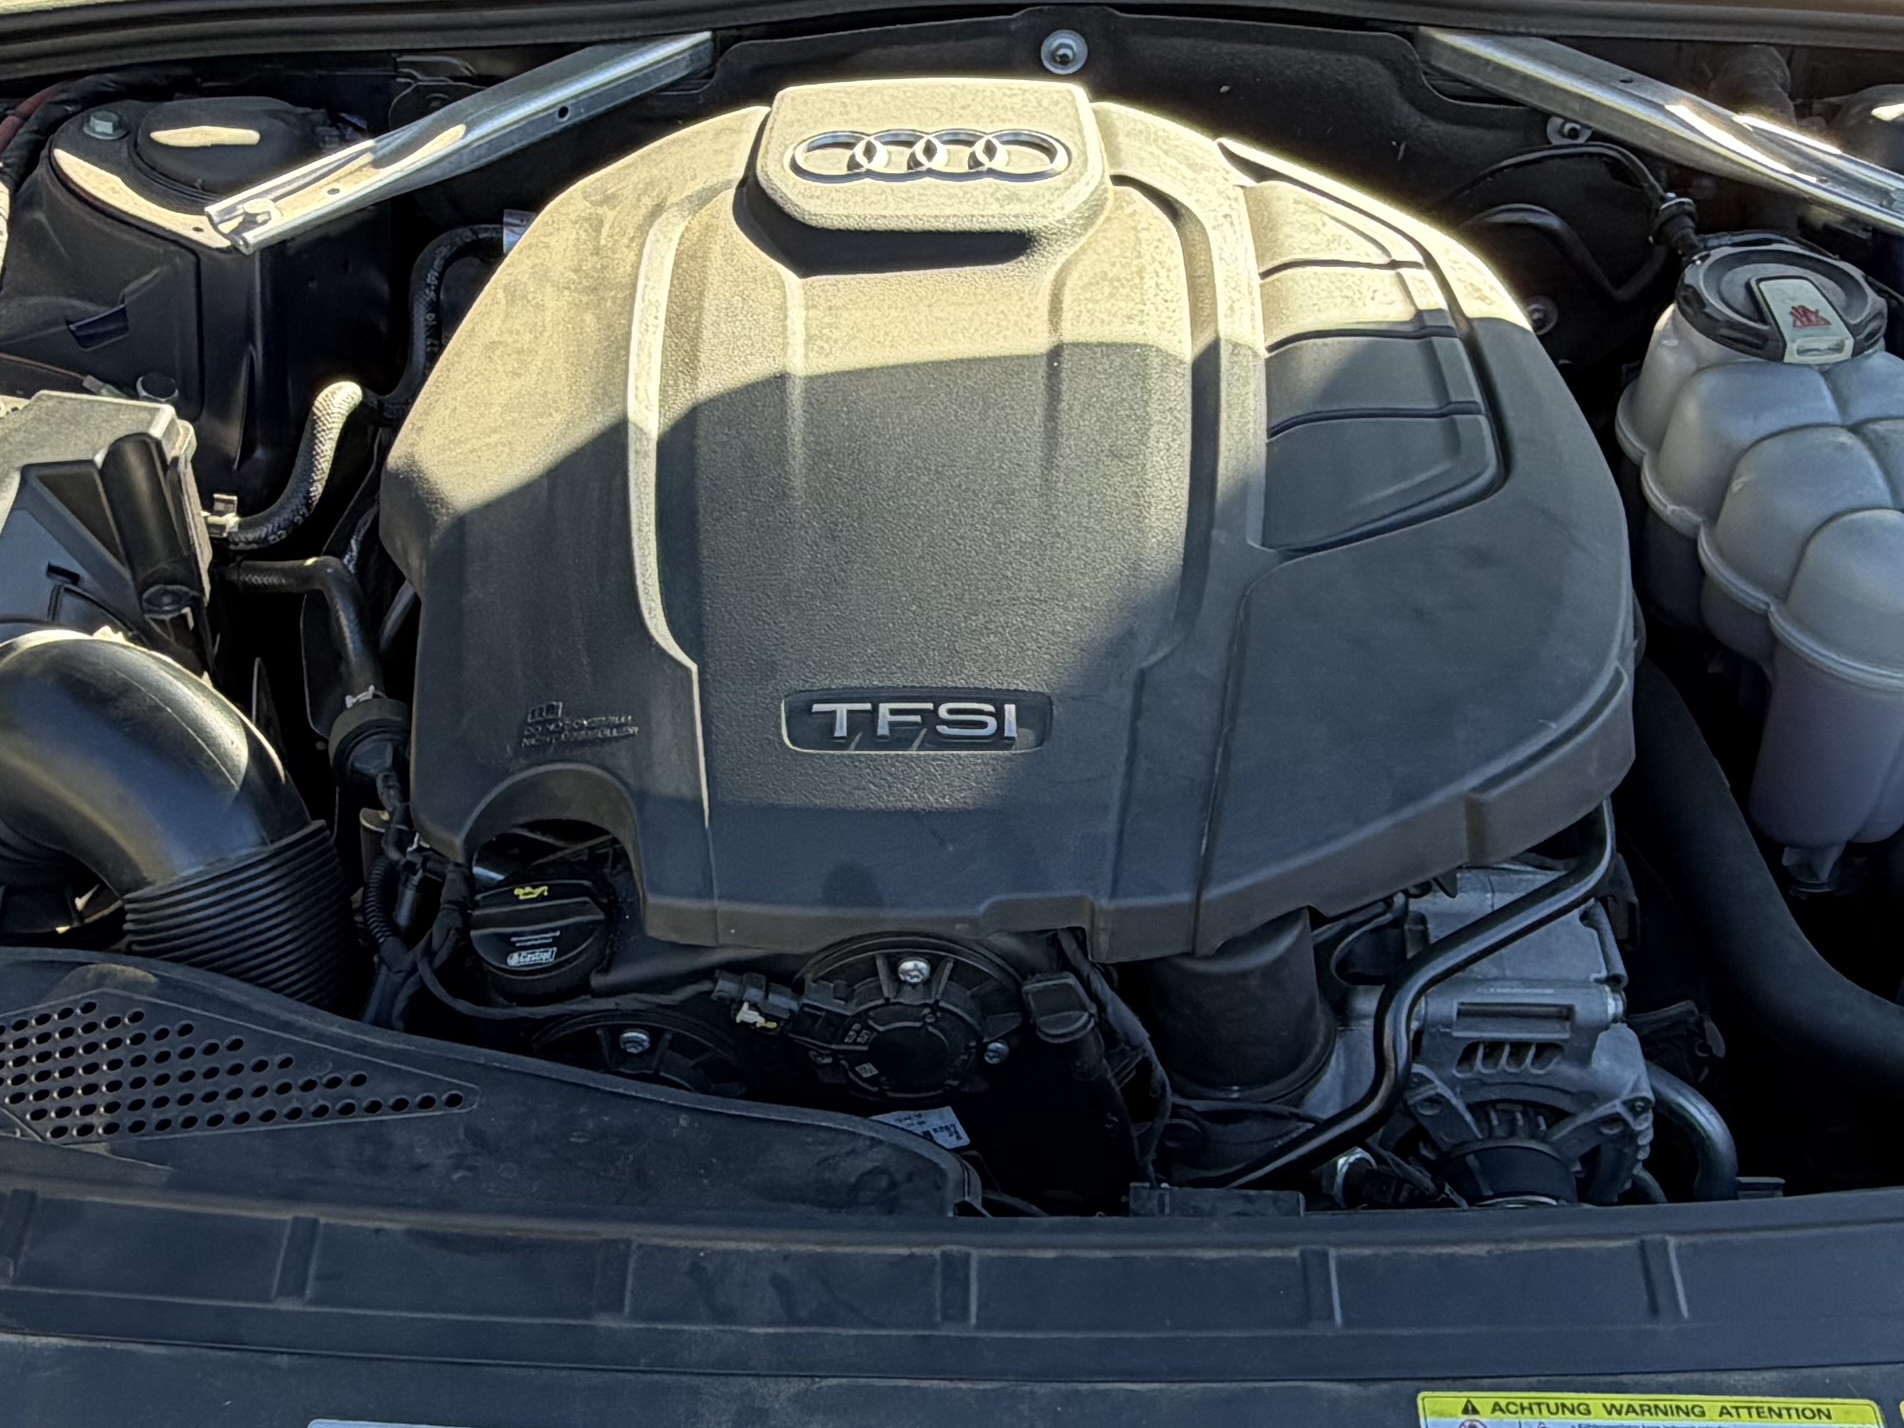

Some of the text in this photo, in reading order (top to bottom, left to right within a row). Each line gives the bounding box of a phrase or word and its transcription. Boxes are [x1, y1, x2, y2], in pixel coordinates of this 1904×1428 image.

[811, 701, 1017, 739] TFSI
[1491, 1400, 1833, 1421] ACHTUNG WARNING ATTENTION
